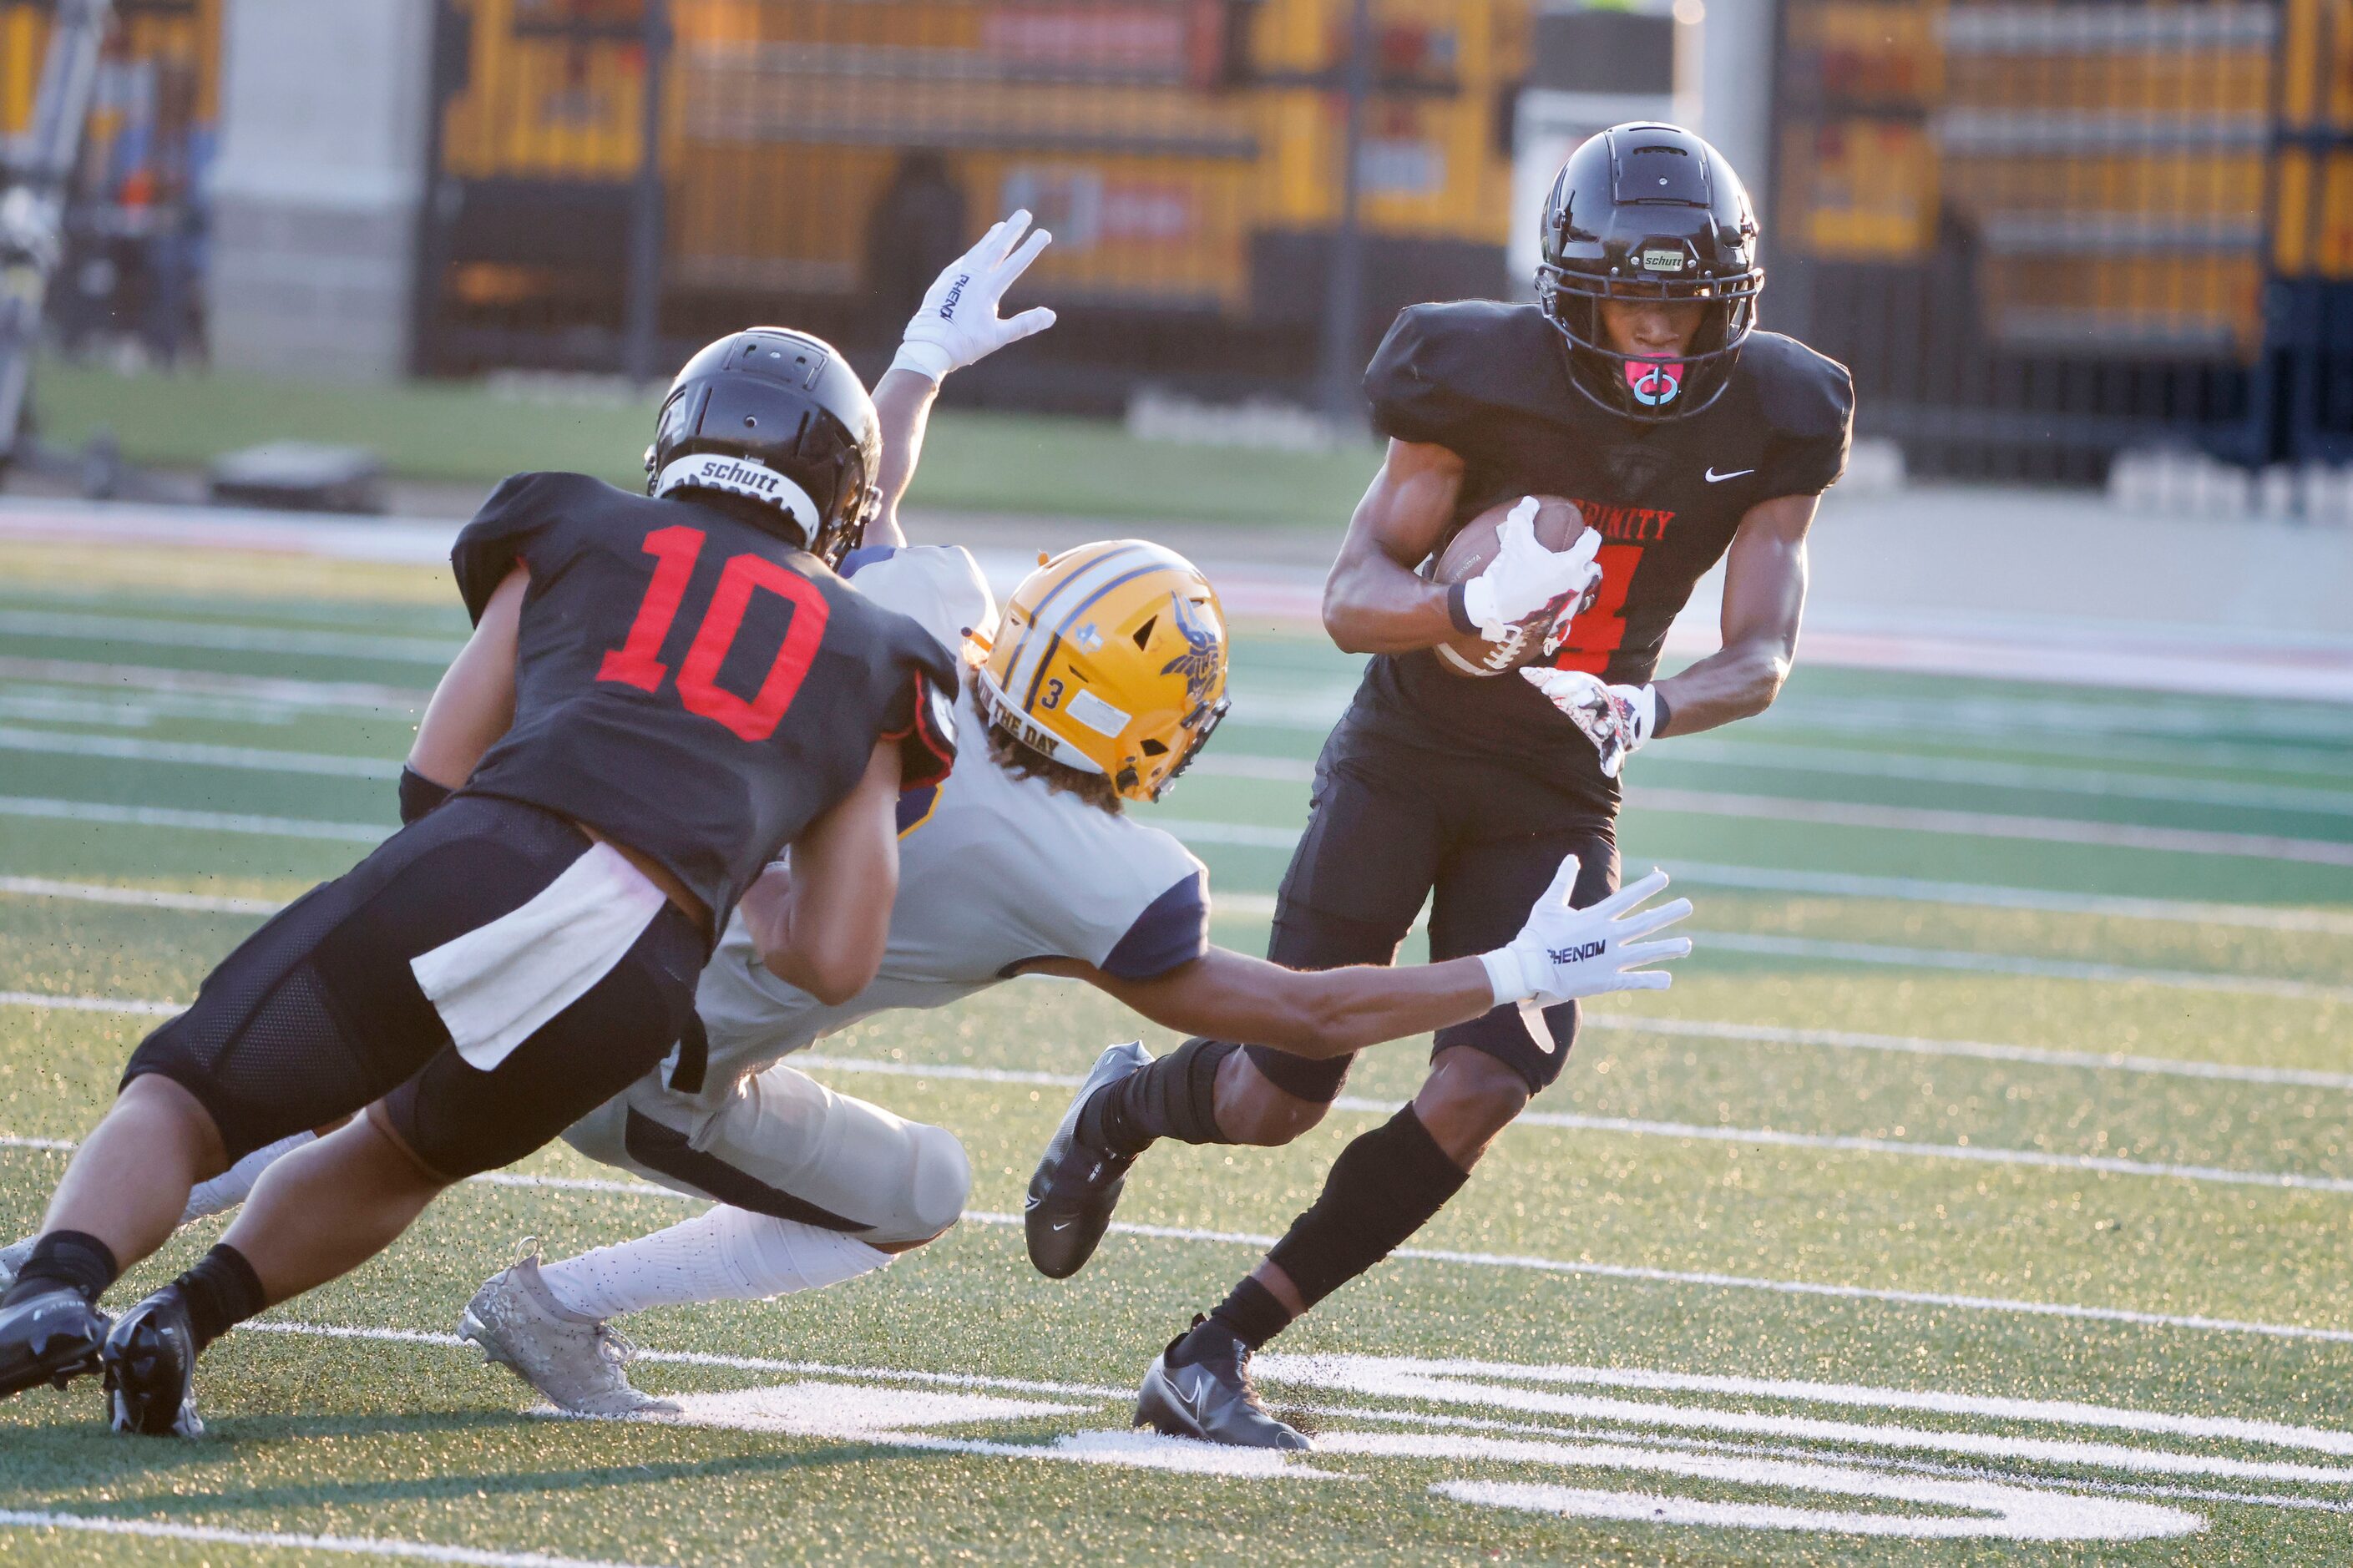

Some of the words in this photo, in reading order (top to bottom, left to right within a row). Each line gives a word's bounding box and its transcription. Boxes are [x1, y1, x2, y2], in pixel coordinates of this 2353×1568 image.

[1645, 255, 1682, 266] schutt
[701, 461, 779, 493] schutt
[595, 524, 830, 741] 10
[1041, 678, 1064, 710] 3
[994, 698, 1023, 737] THE
[1024, 725, 1060, 756] DAY
